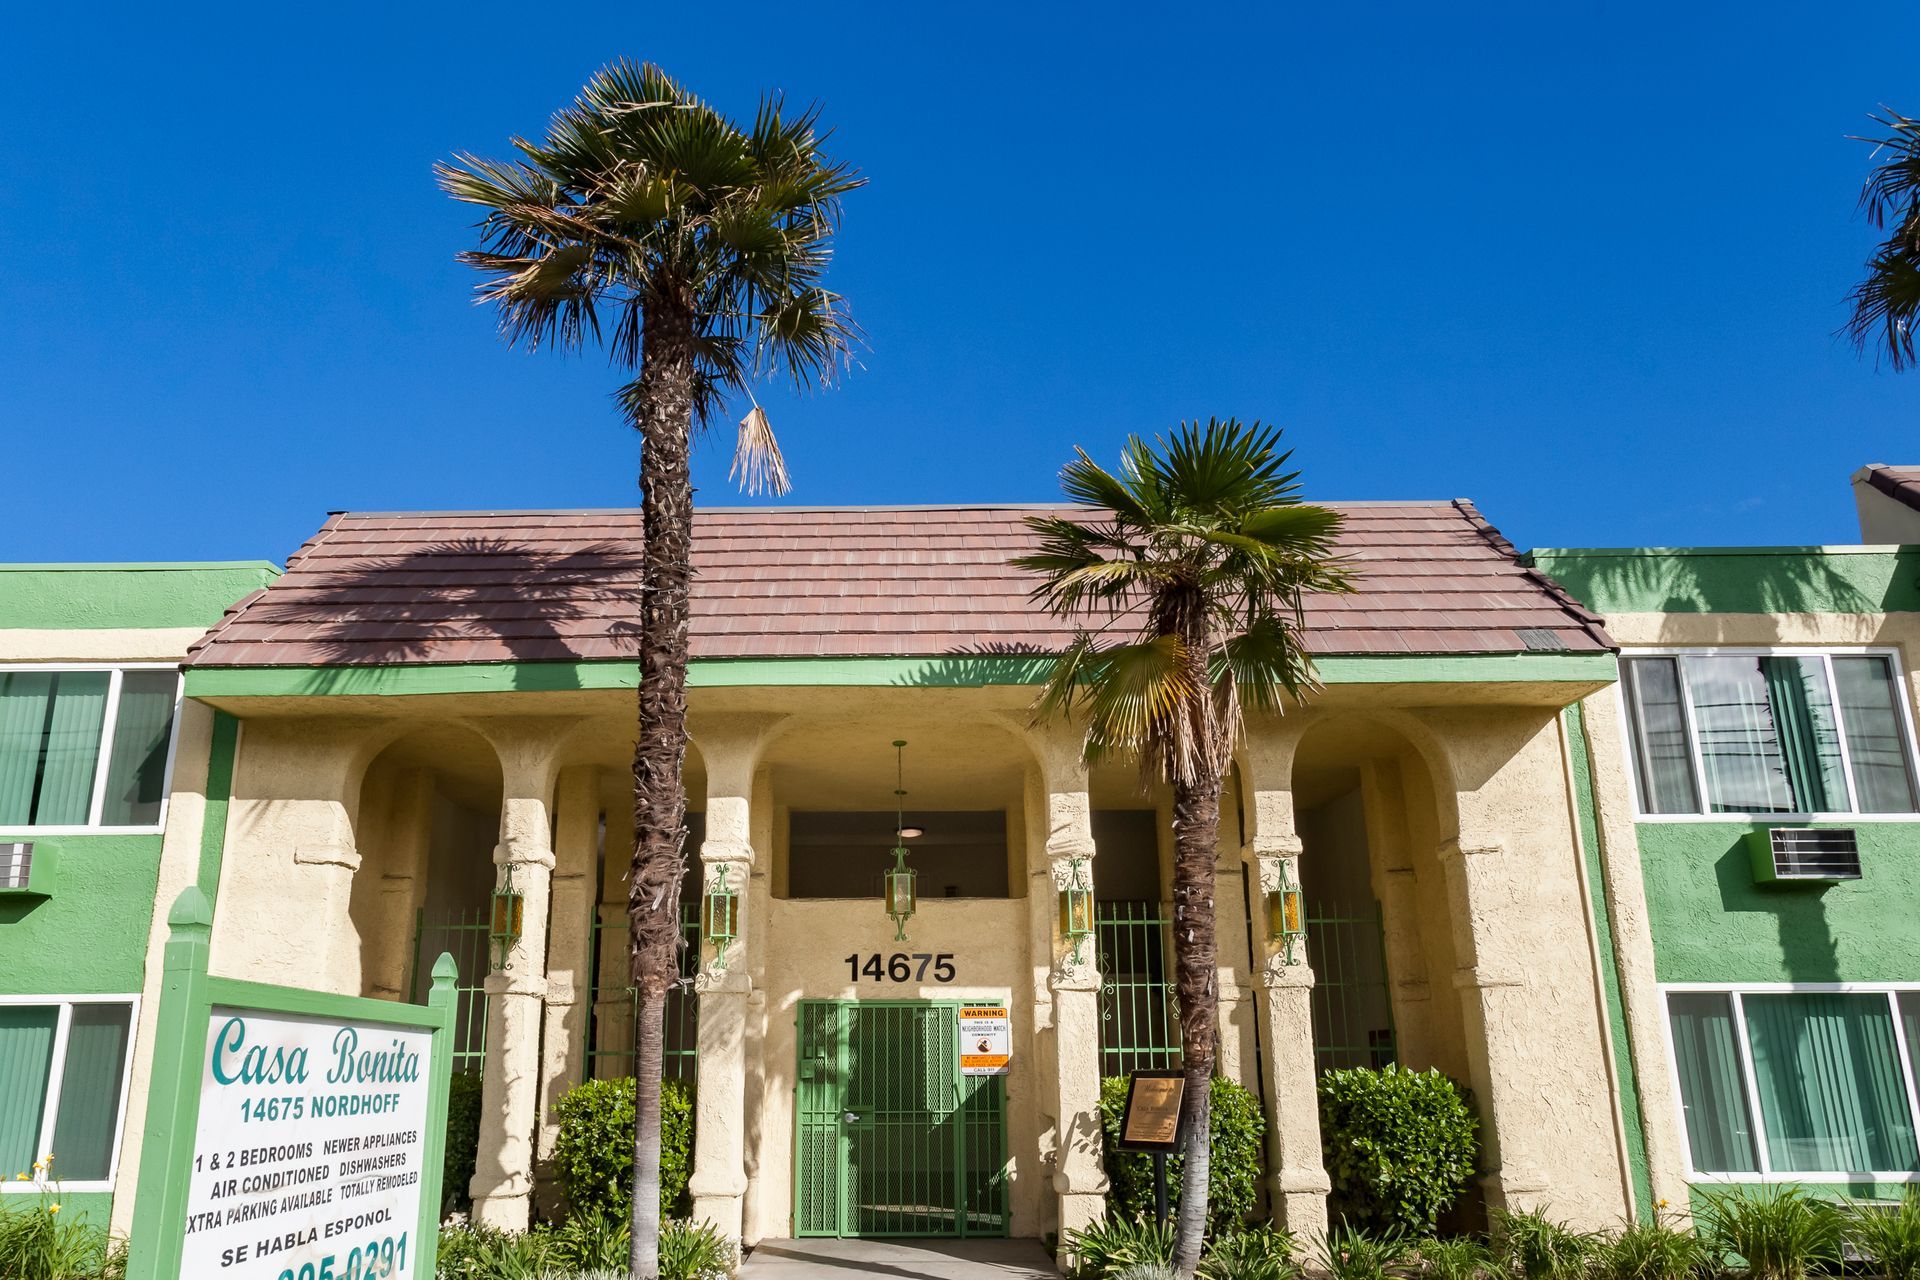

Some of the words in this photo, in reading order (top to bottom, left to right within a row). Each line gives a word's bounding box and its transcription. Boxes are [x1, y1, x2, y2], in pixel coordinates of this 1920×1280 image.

[845, 953, 956, 983] 14675
[212, 1017, 309, 1085] Casa
[326, 1027, 419, 1084] Bonita
[241, 1097, 304, 1123] 14675
[311, 1093, 400, 1118] NORDHOFF
[195, 1154, 203, 1173] 1
[210, 1153, 220, 1171] &
[226, 1151, 235, 1169] 2
[240, 1142, 313, 1167] BEDROOMS
[323, 1137, 360, 1155] NEWER
[362, 1130, 417, 1150] APPLIANCES
[210, 1179, 238, 1200] AIR
[242, 1165, 330, 1194] CONDITIONED
[339, 1152, 407, 1177] DISHWASHERS
[185, 1210, 222, 1235] XTRA
[226, 1200, 278, 1226] PARKING
[280, 1188, 333, 1214] AVAILABLE
[340, 1179, 378, 1200] TOTALLY
[376, 1171, 418, 1192] REMODELED
[220, 1245, 248, 1268] SE
[256, 1227, 318, 1258] HABLA
[324, 1208, 392, 1239] ESPONOL
